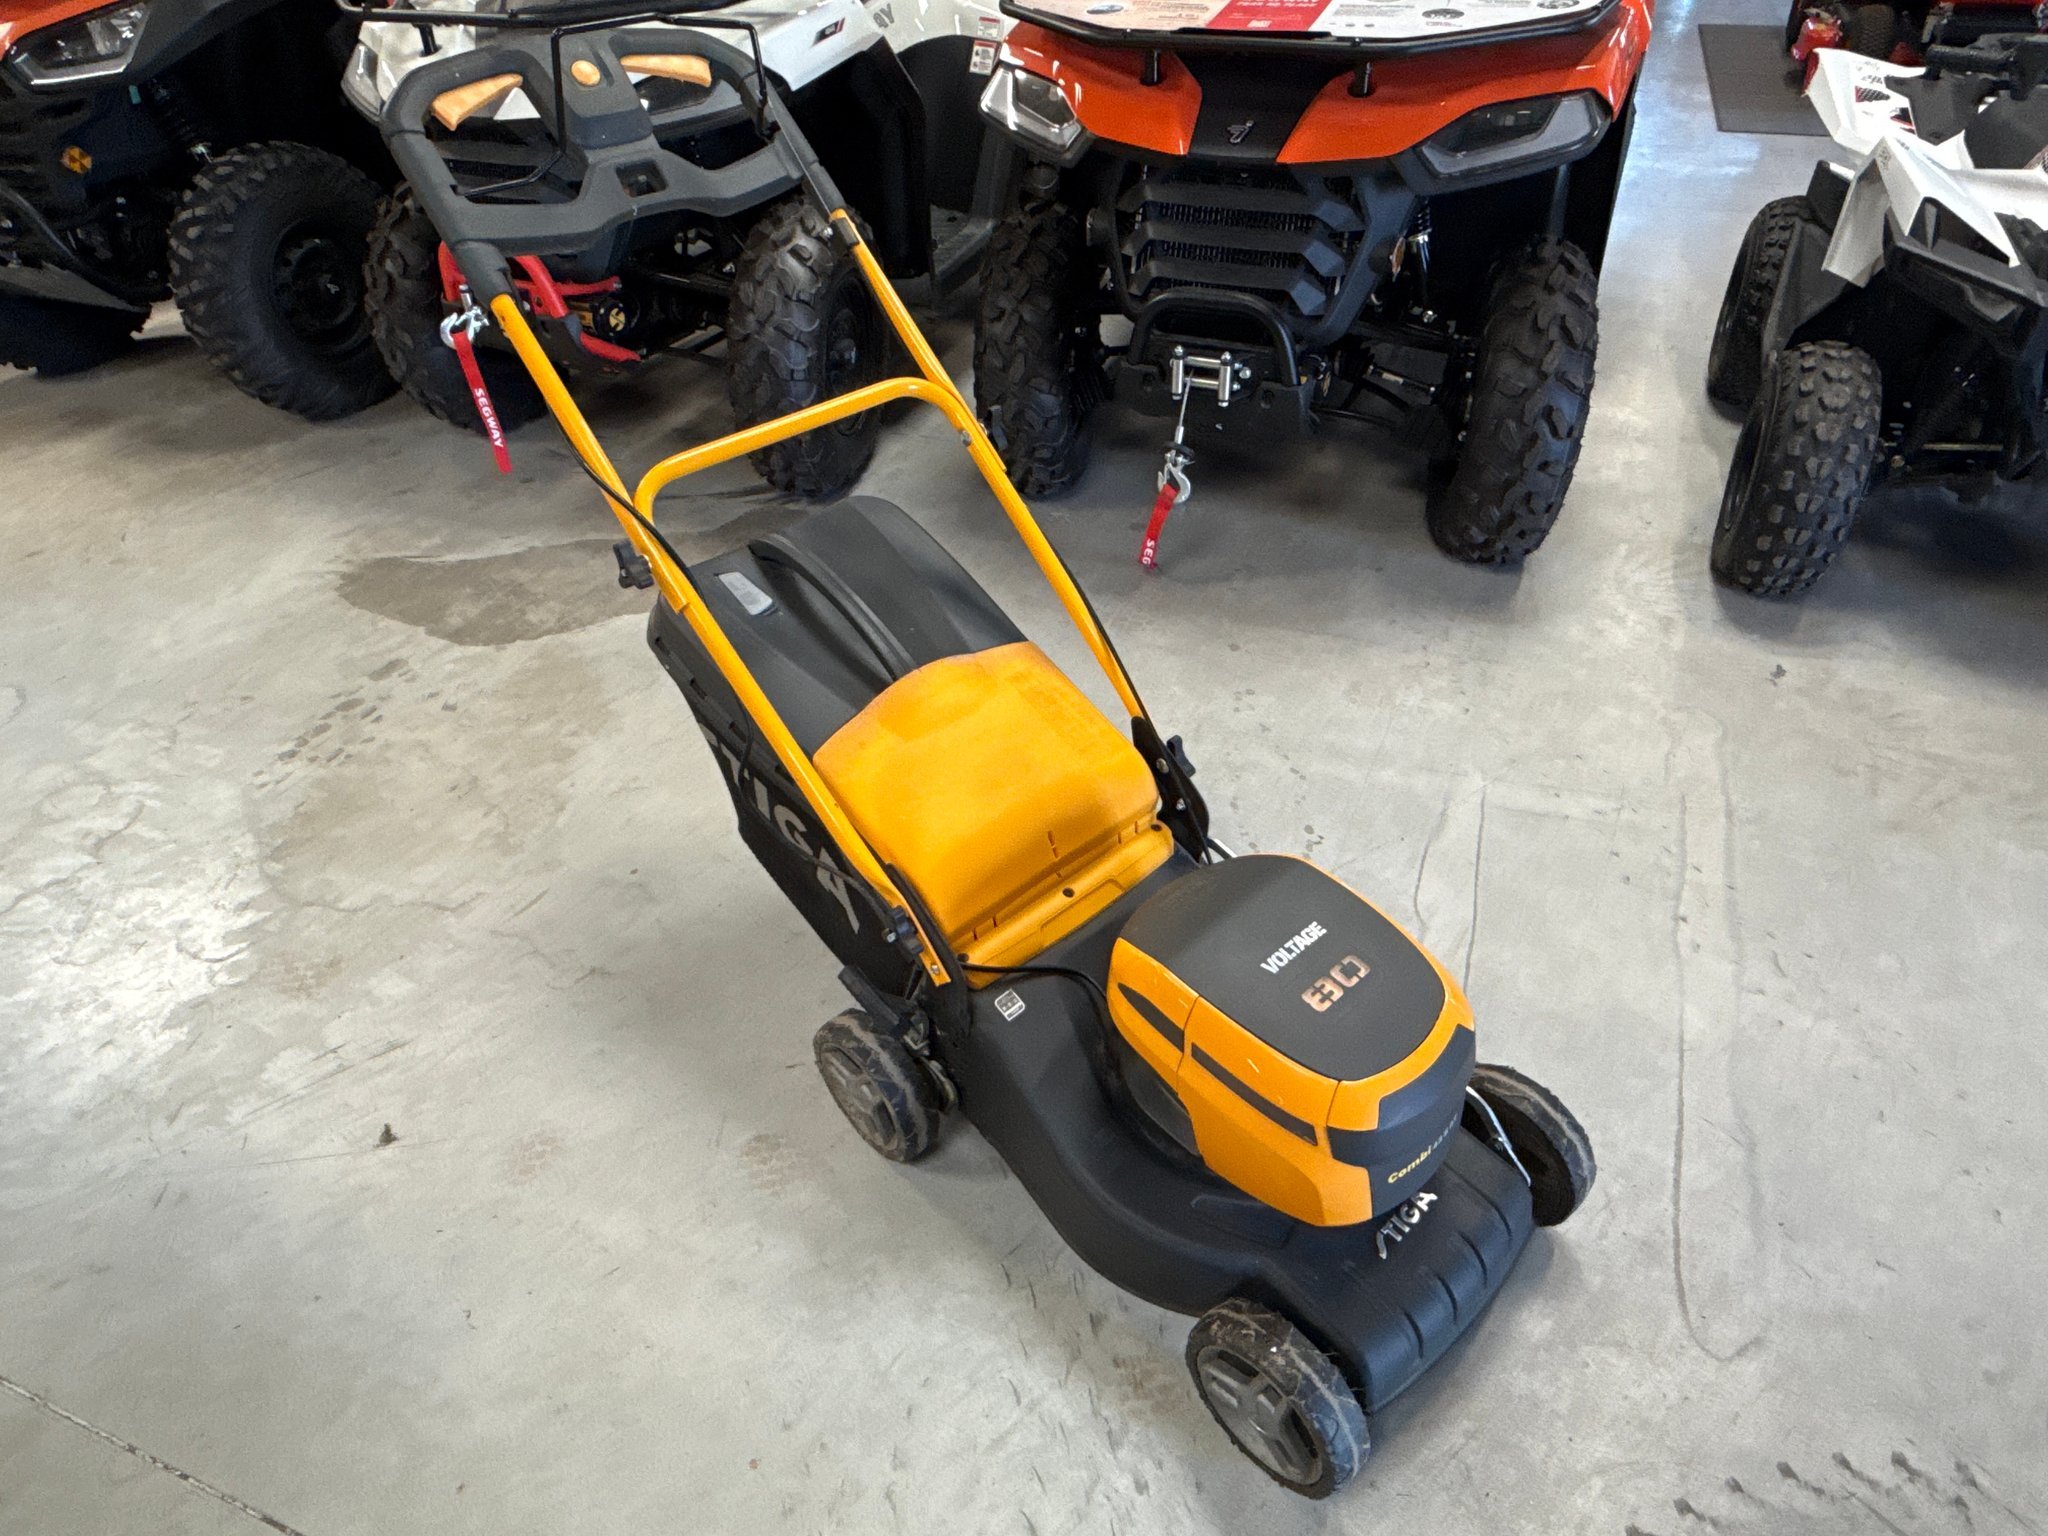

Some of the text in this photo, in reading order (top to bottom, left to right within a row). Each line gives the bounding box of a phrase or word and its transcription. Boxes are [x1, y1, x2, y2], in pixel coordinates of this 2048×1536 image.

[475, 388, 504, 448] SEGWAY
[1142, 538, 1155, 565] SEG
[1260, 921, 1327, 974] VOLTAGE
[1301, 955, 1371, 1012] 80
[1387, 1145, 1432, 1184] Combi
[1376, 1191, 1438, 1260] STIGA
